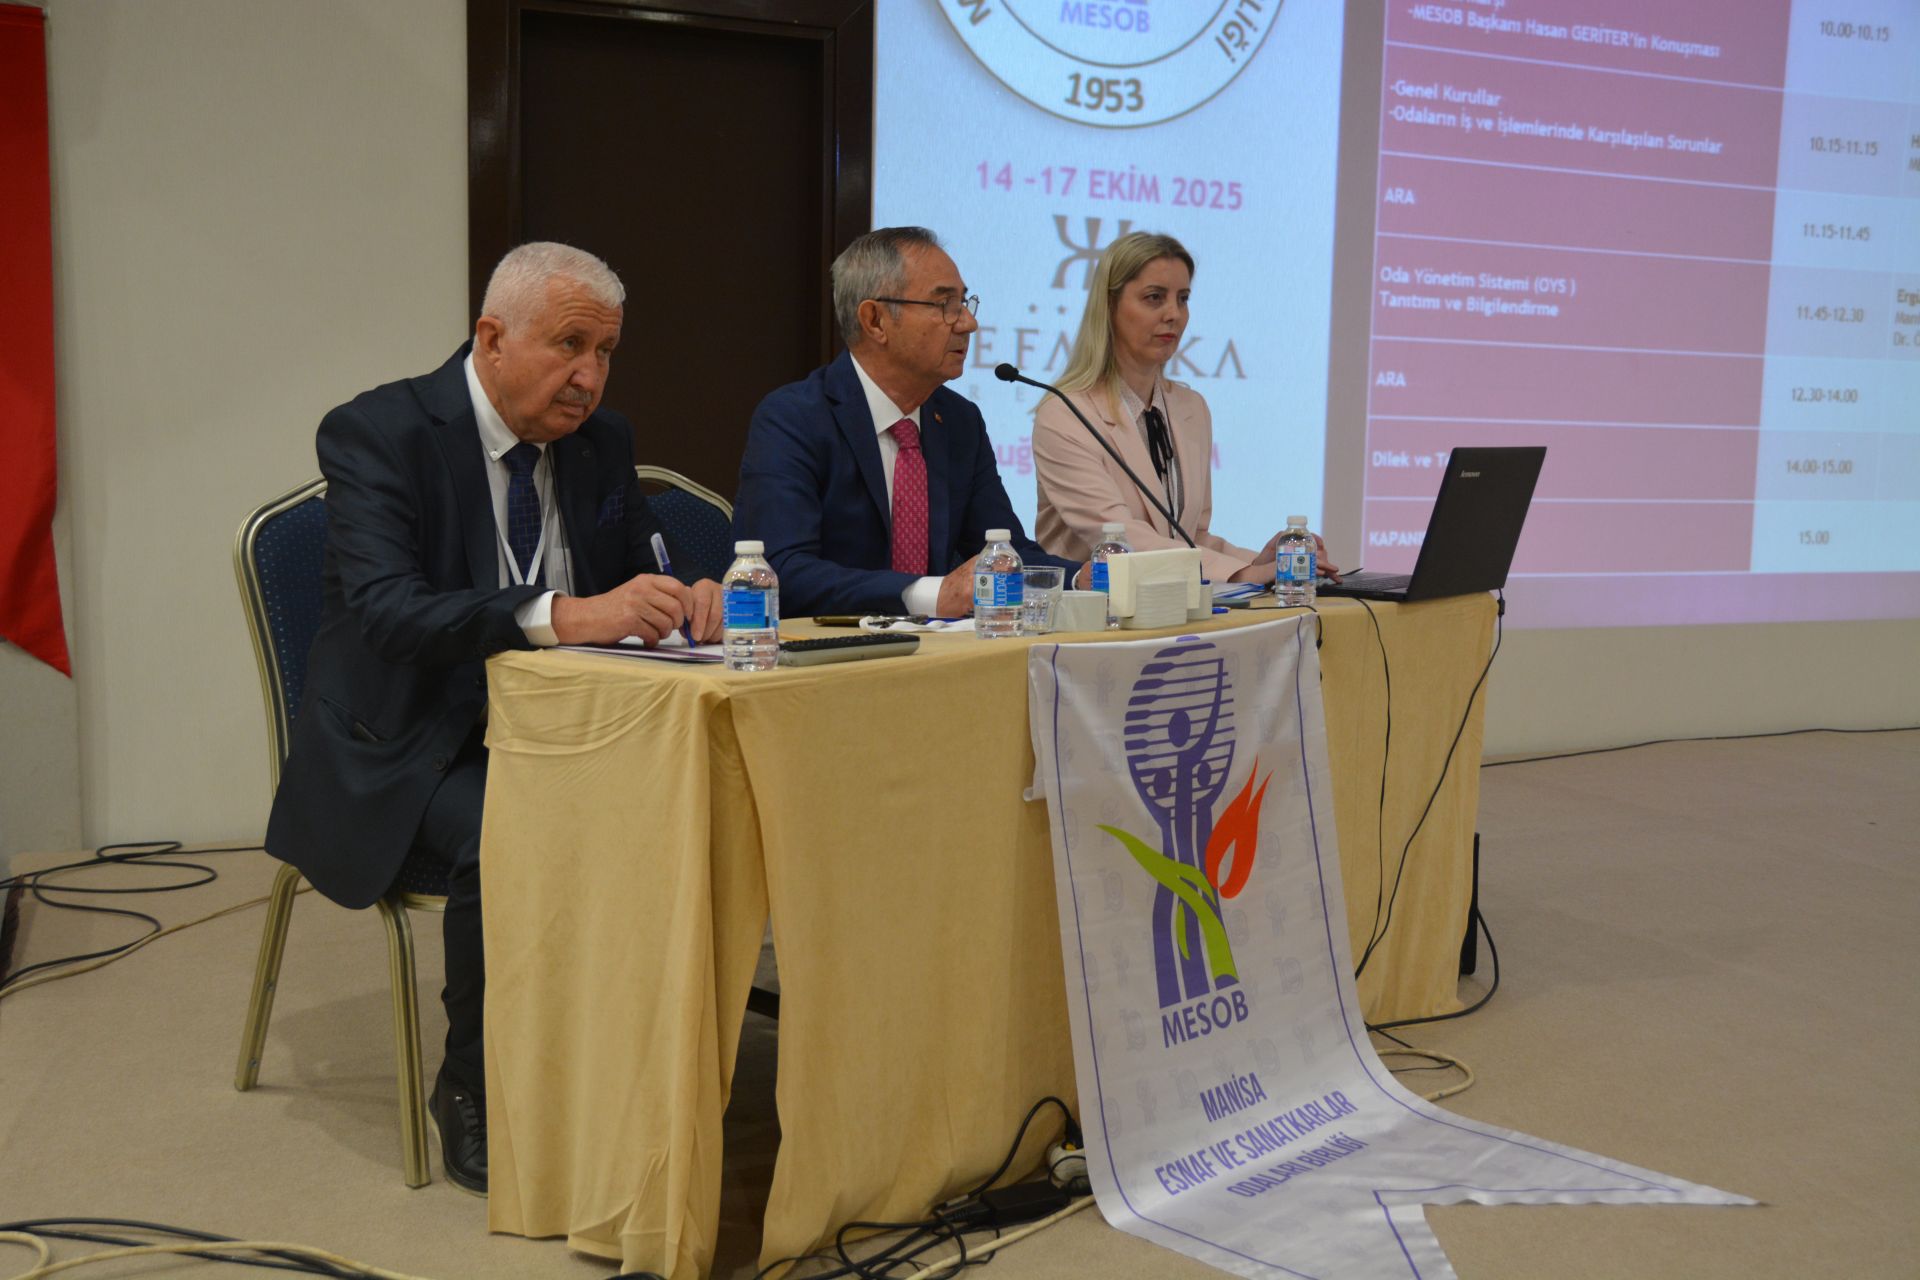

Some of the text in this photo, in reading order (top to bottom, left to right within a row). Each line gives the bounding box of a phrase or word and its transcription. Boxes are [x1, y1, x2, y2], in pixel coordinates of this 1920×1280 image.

[1059, 3, 1150, 33] MESOB
[1215, 0, 1262, 63] LİĞİ
[1408, 4, 1463, 25] -MESOB
[1467, 11, 1521, 34] Başkanı
[1525, 18, 1567, 38] Hasan
[1650, 35, 1721, 58] Konuşması
[1820, 20, 1889, 42] 10.00-10.15
[1064, 72, 1144, 112] 1953
[1443, 85, 1502, 107] Kurullar
[1476, 117, 1493, 131] ve
[1497, 110, 1584, 140] İşlemlerinde
[1667, 135, 1722, 155] Sorunlar
[1810, 137, 1878, 156] 10.15-11.15
[976, 161, 1243, 211] 14 -17 EKİM 2025
[1384, 188, 1415, 205] ARA
[1803, 223, 1870, 241] 11.15-11.45
[1380, 266, 1409, 283] Oda
[1415, 268, 1475, 288] Yönetim
[1479, 273, 1529, 291] Sistemi
[1445, 299, 1461, 311] ve
[1466, 297, 1559, 317] Bilgilendirme
[1797, 306, 1864, 323] 11.45-12.30
[971, 326, 1247, 379] EFAKA
[1376, 371, 1406, 387] ARA
[1792, 388, 1858, 403] 12.30-14.00
[1372, 452, 1409, 467] Dilek
[1414, 456, 1432, 467] ve
[1786, 459, 1853, 474] 14.00-15.00
[1369, 531, 1426, 546] KAPANI
[1799, 530, 1829, 545] 15.00
[1161, 990, 1249, 1049] MESOB
[1199, 1072, 1267, 1123] MANİSA
[1155, 1090, 1359, 1196] ESNAF VE SANATKARLAR
[1226, 1131, 1370, 1198] ODALARI BİRLİĞİ
